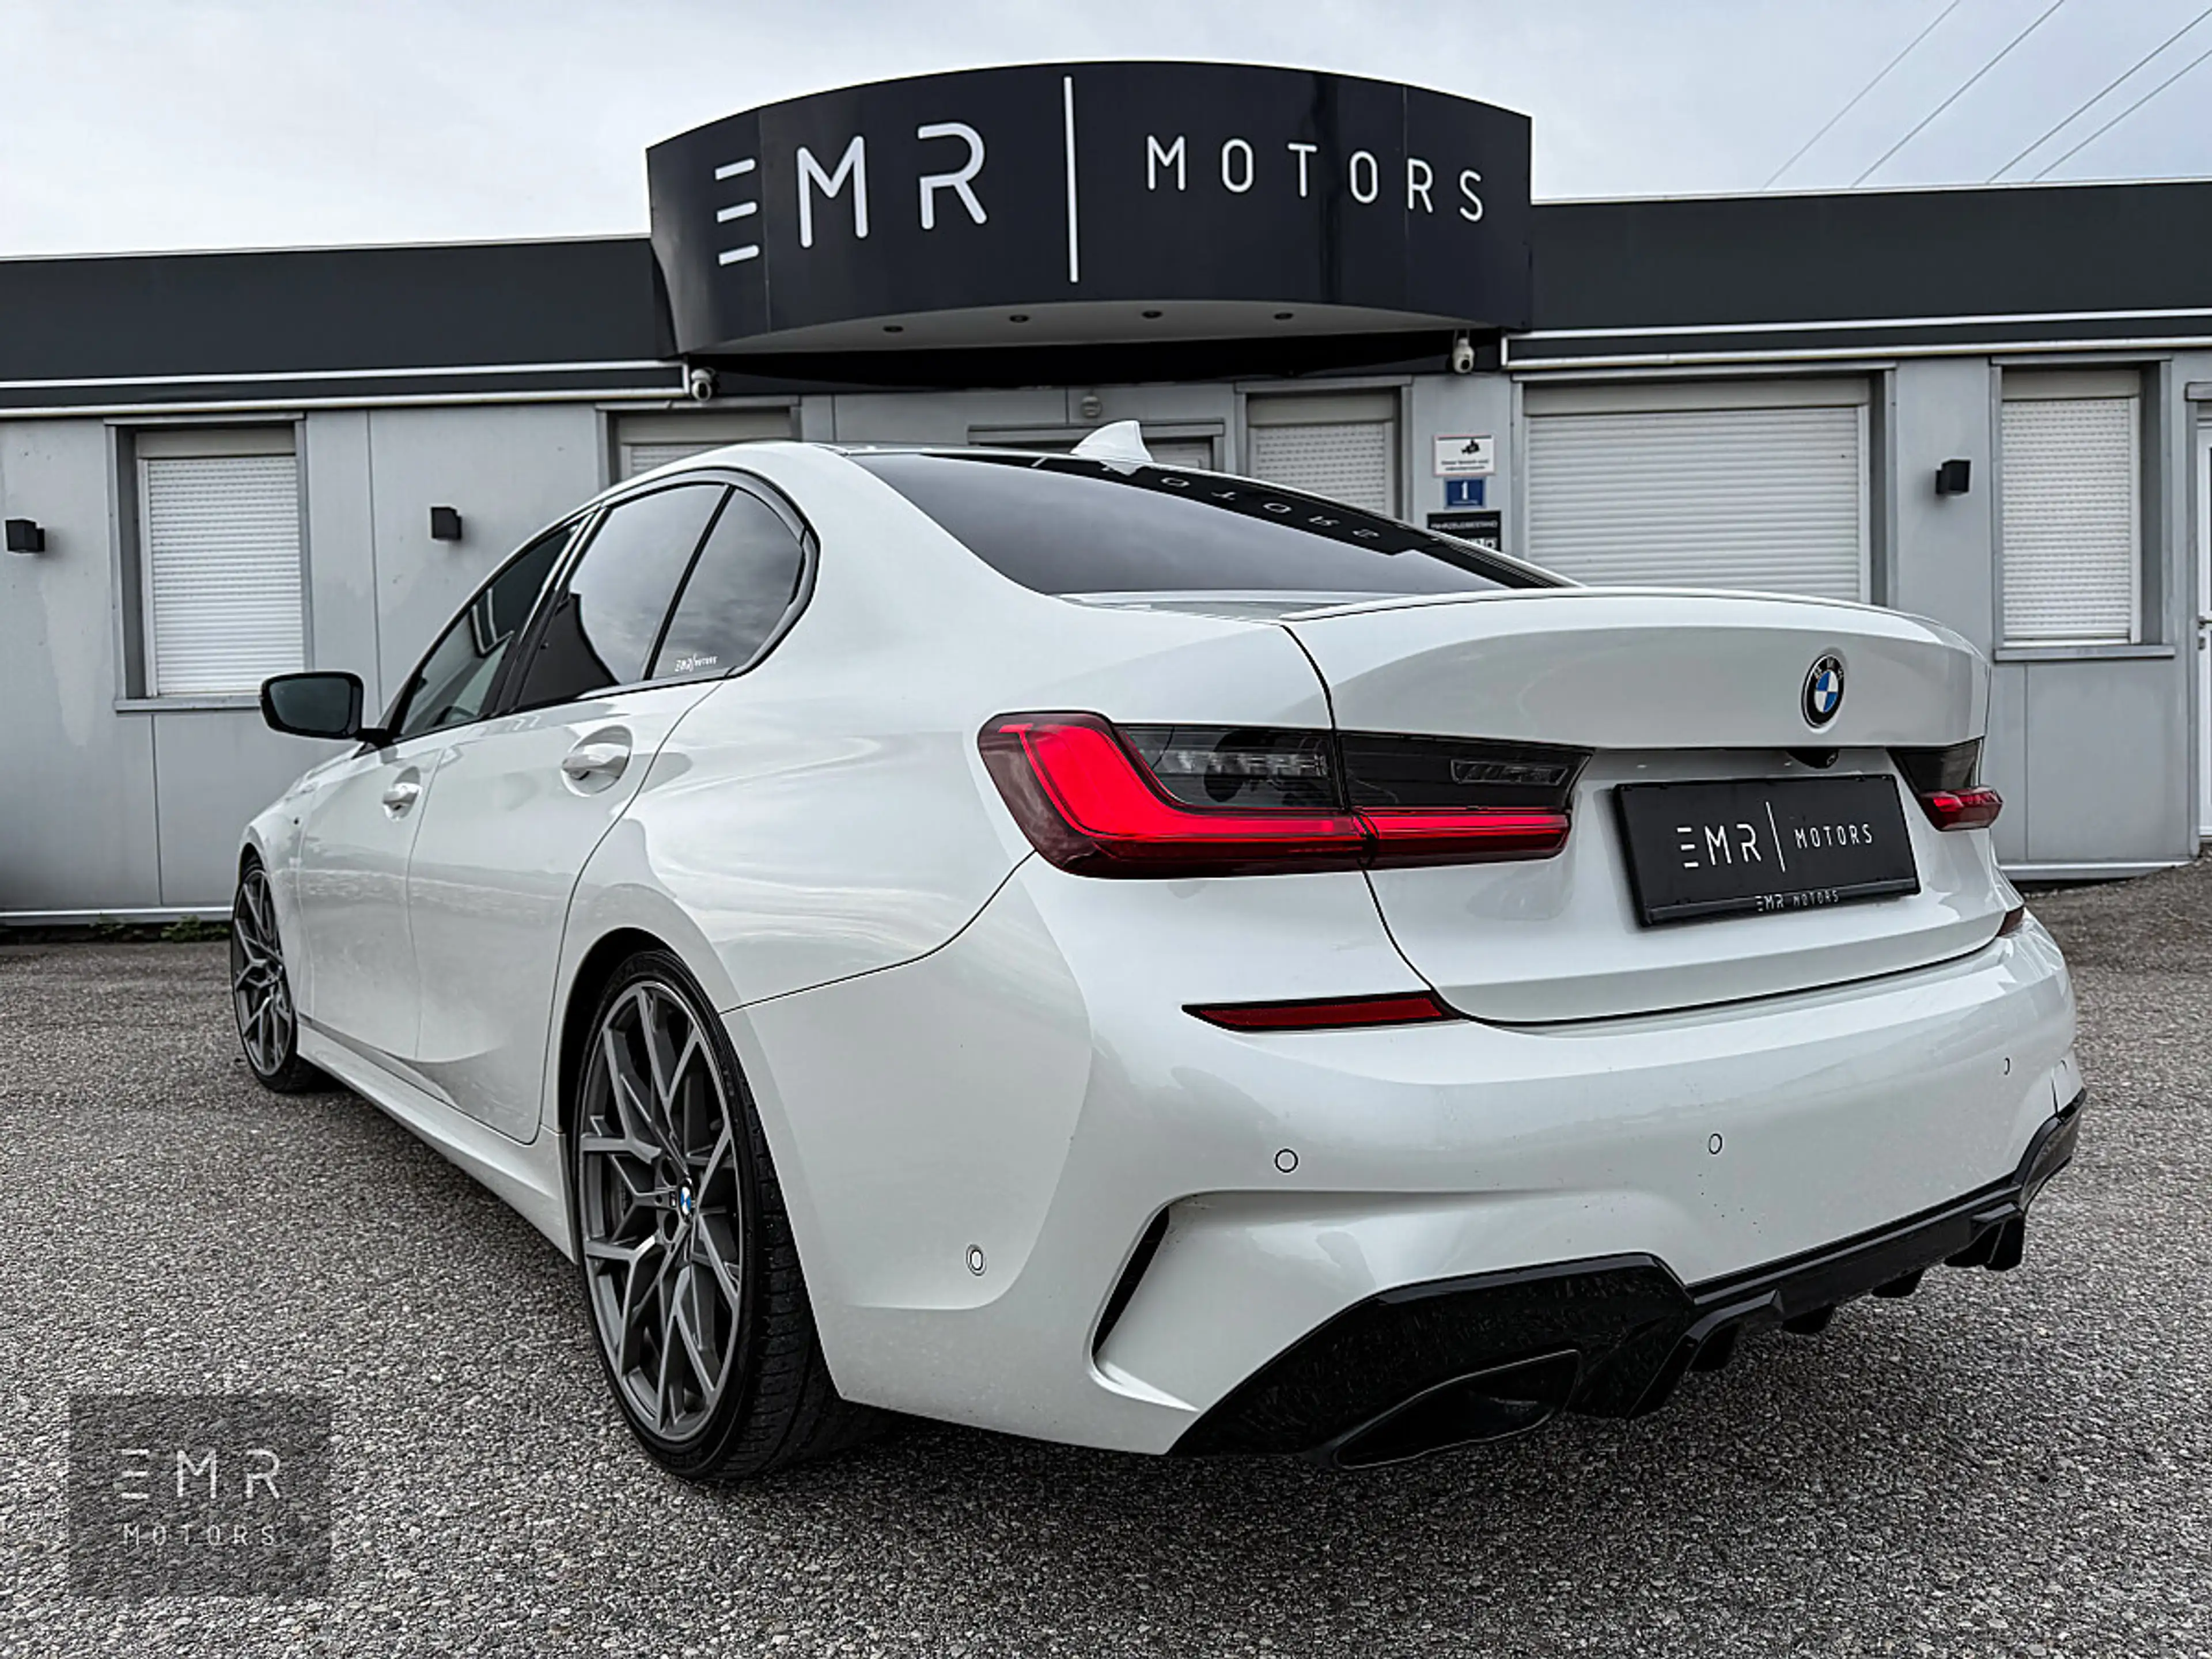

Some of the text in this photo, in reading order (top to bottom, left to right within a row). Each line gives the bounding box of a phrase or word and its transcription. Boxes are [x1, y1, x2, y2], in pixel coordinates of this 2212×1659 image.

[714, 122, 1484, 266] EMR MOTORS
[1461, 481, 1468, 499] 1
[1677, 823, 1873, 868] EMR MOTORS
[1755, 889, 1839, 912] EMR MOTORS
